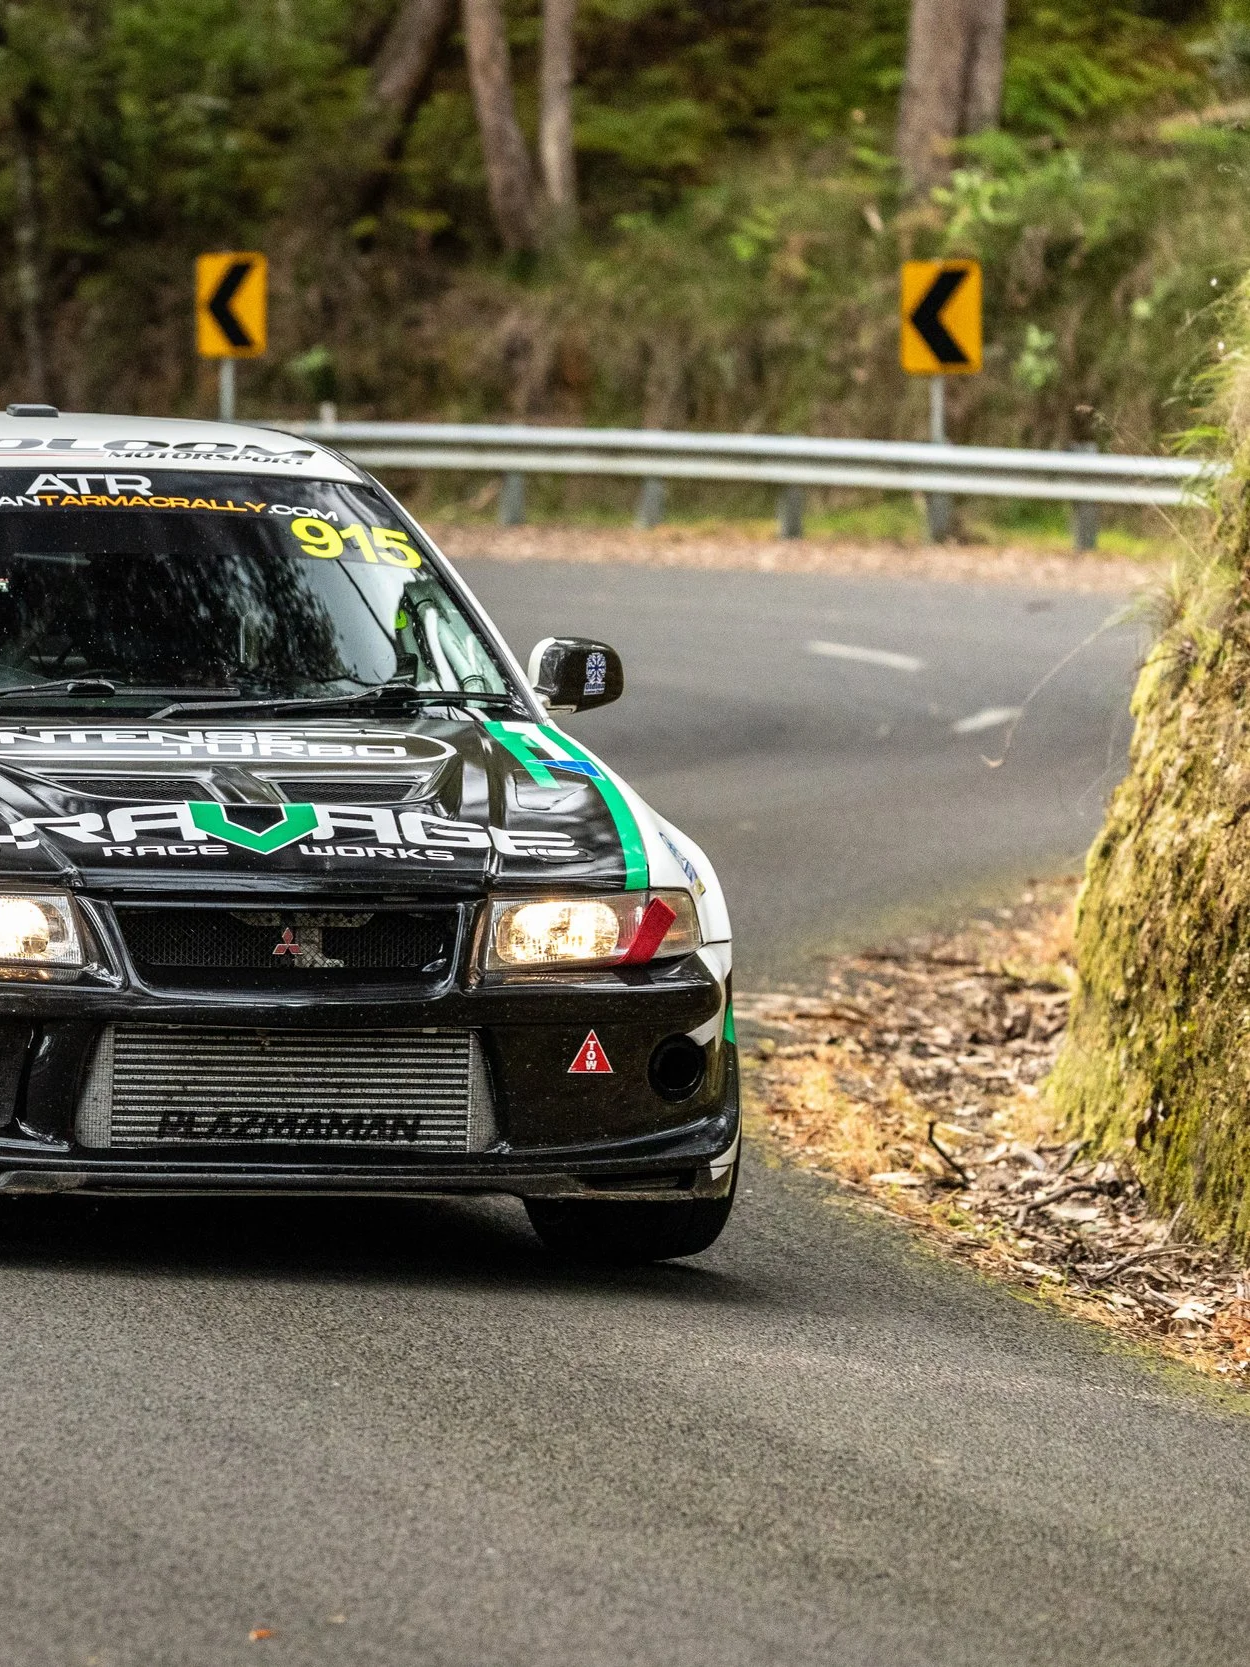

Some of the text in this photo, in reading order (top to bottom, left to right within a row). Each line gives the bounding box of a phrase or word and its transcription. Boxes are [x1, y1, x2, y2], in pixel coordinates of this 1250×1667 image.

[108, 450, 306, 465] MOTORSPORT
[24, 473, 154, 497] ATR
[290, 517, 423, 569] 915
[162, 744, 408, 758] TURBO
[20, 800, 582, 857] RAVAGE
[102, 844, 456, 862] RACE WORKS
[585, 1040, 598, 1070] TOW
